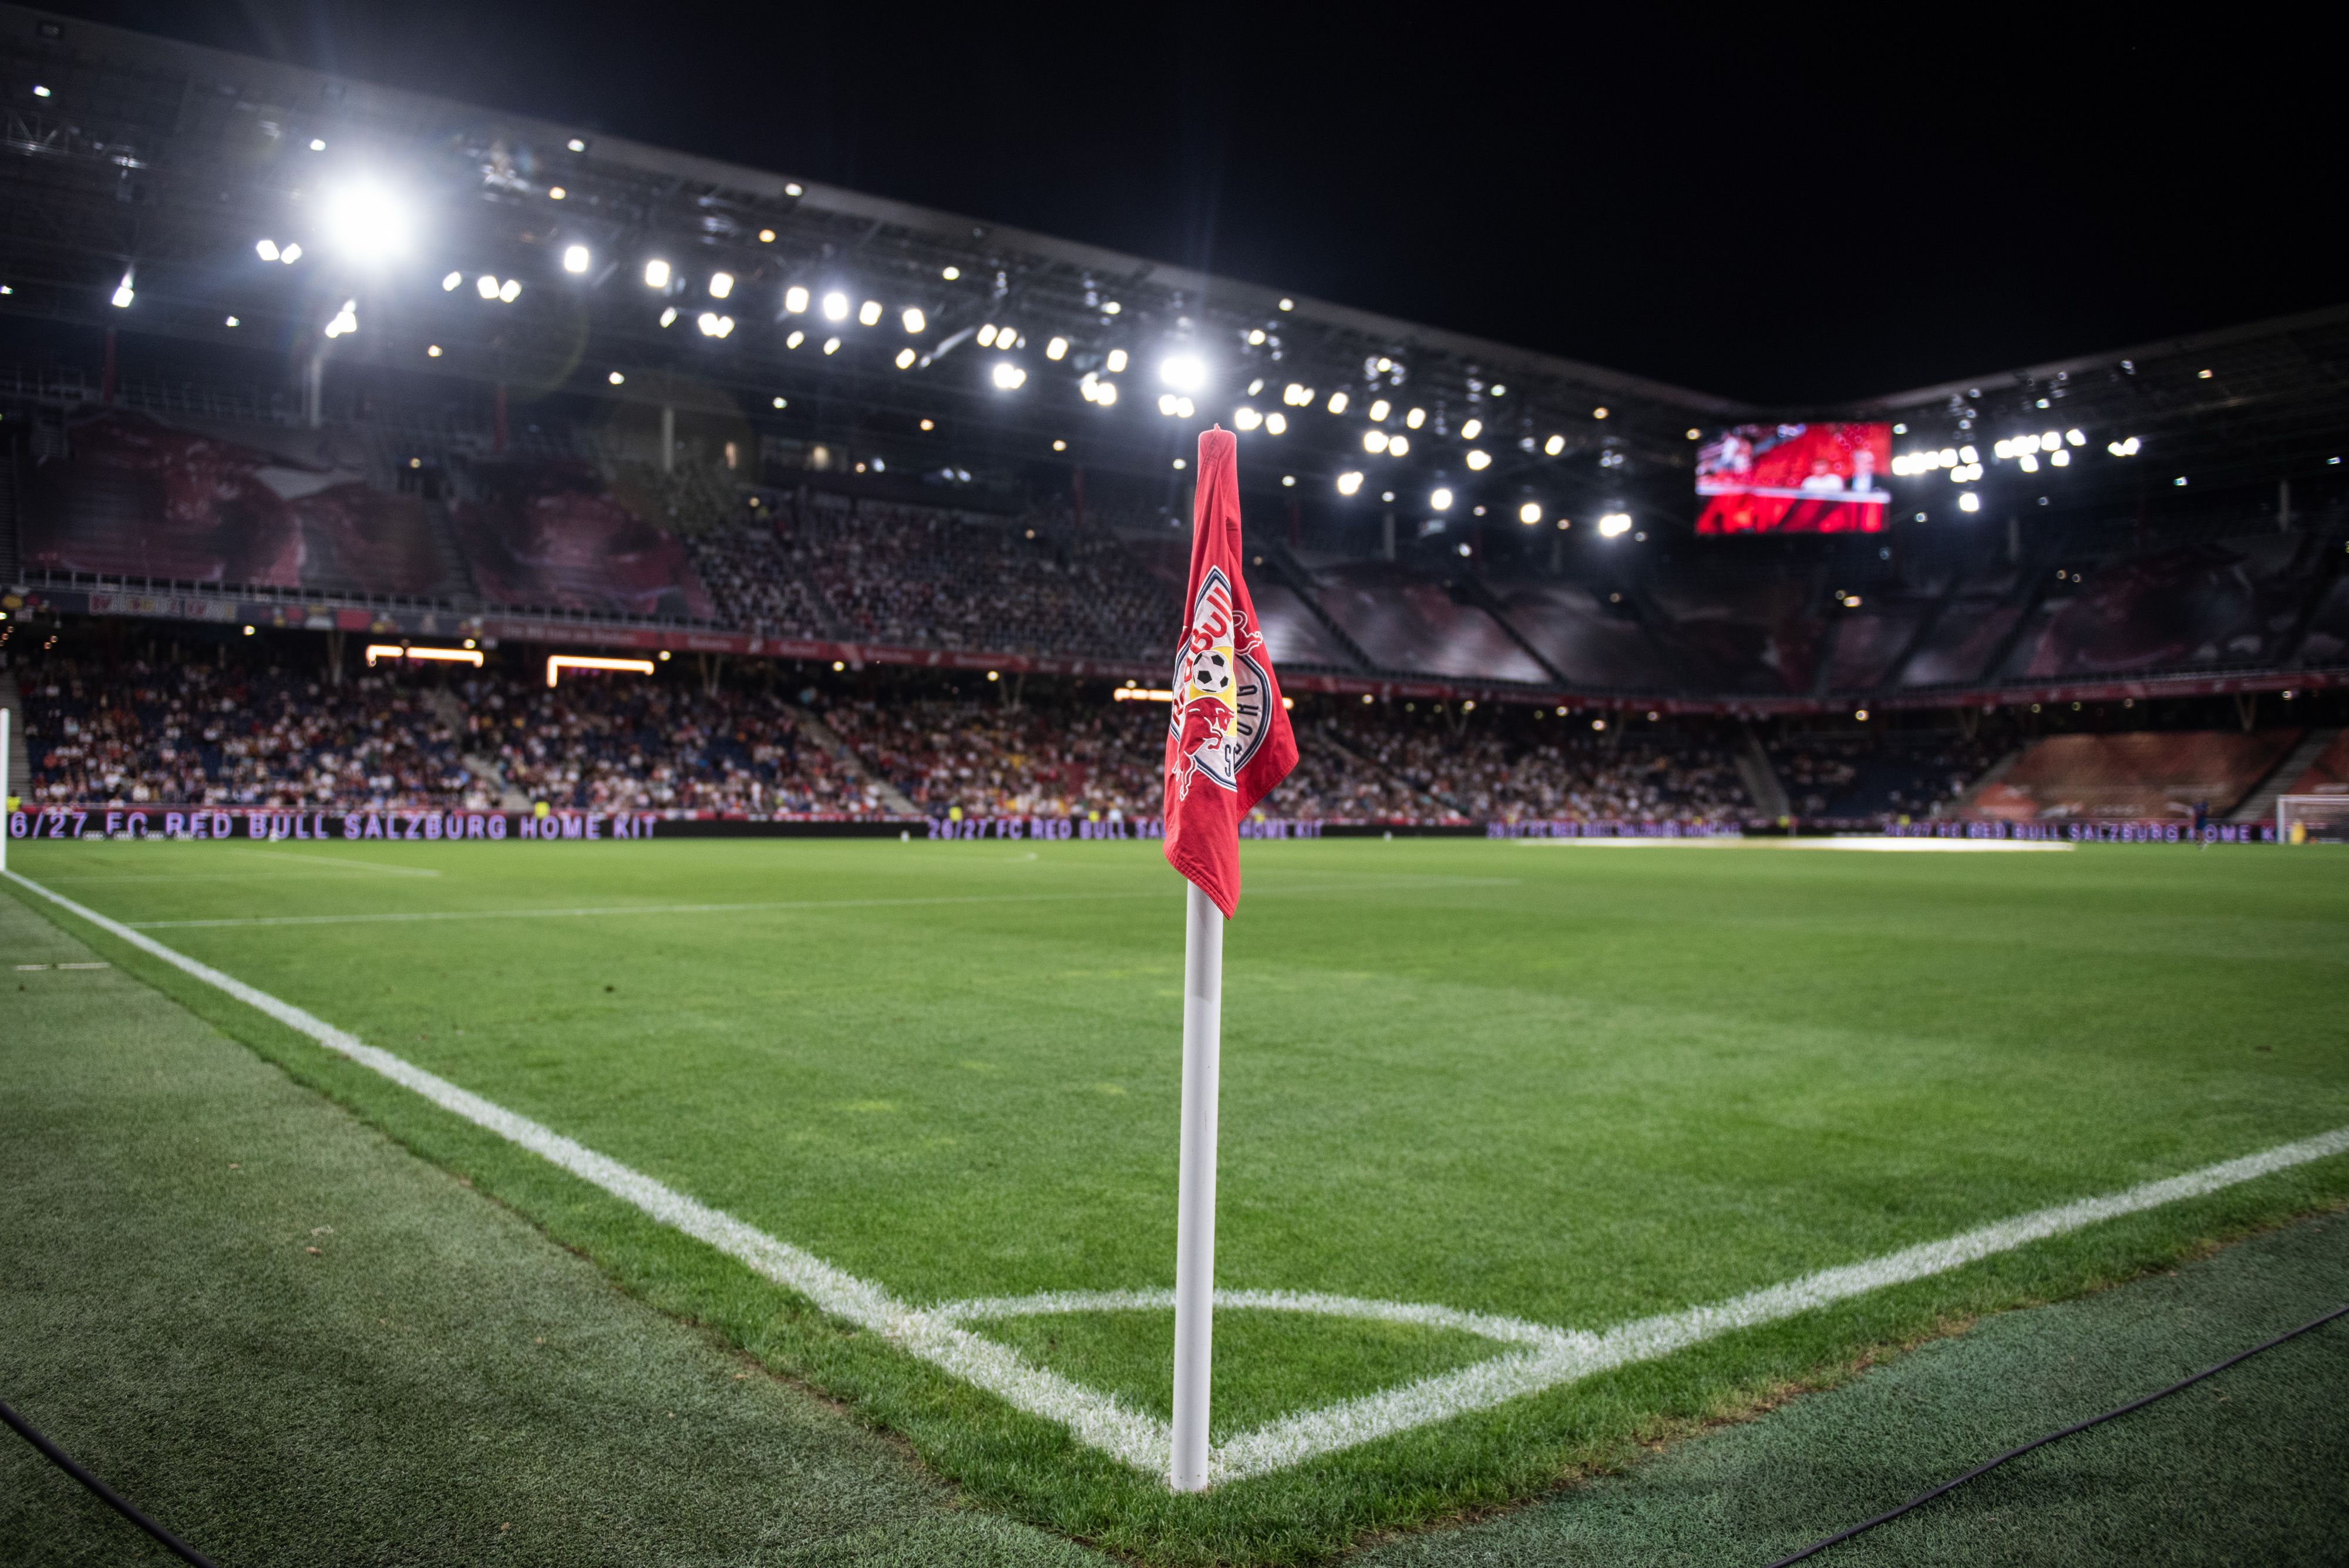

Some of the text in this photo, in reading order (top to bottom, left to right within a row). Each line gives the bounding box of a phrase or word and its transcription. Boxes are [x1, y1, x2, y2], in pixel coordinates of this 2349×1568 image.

[1190, 586, 1233, 656] Bull
[106, 812, 147, 836] FC
[166, 812, 233, 839] RED
[249, 813, 329, 839] BULL
[344, 814, 507, 839] SALZBURG
[520, 814, 601, 840] HOME
[613, 815, 657, 839] KIT
[2068, 823, 2179, 842] SALZBURG
